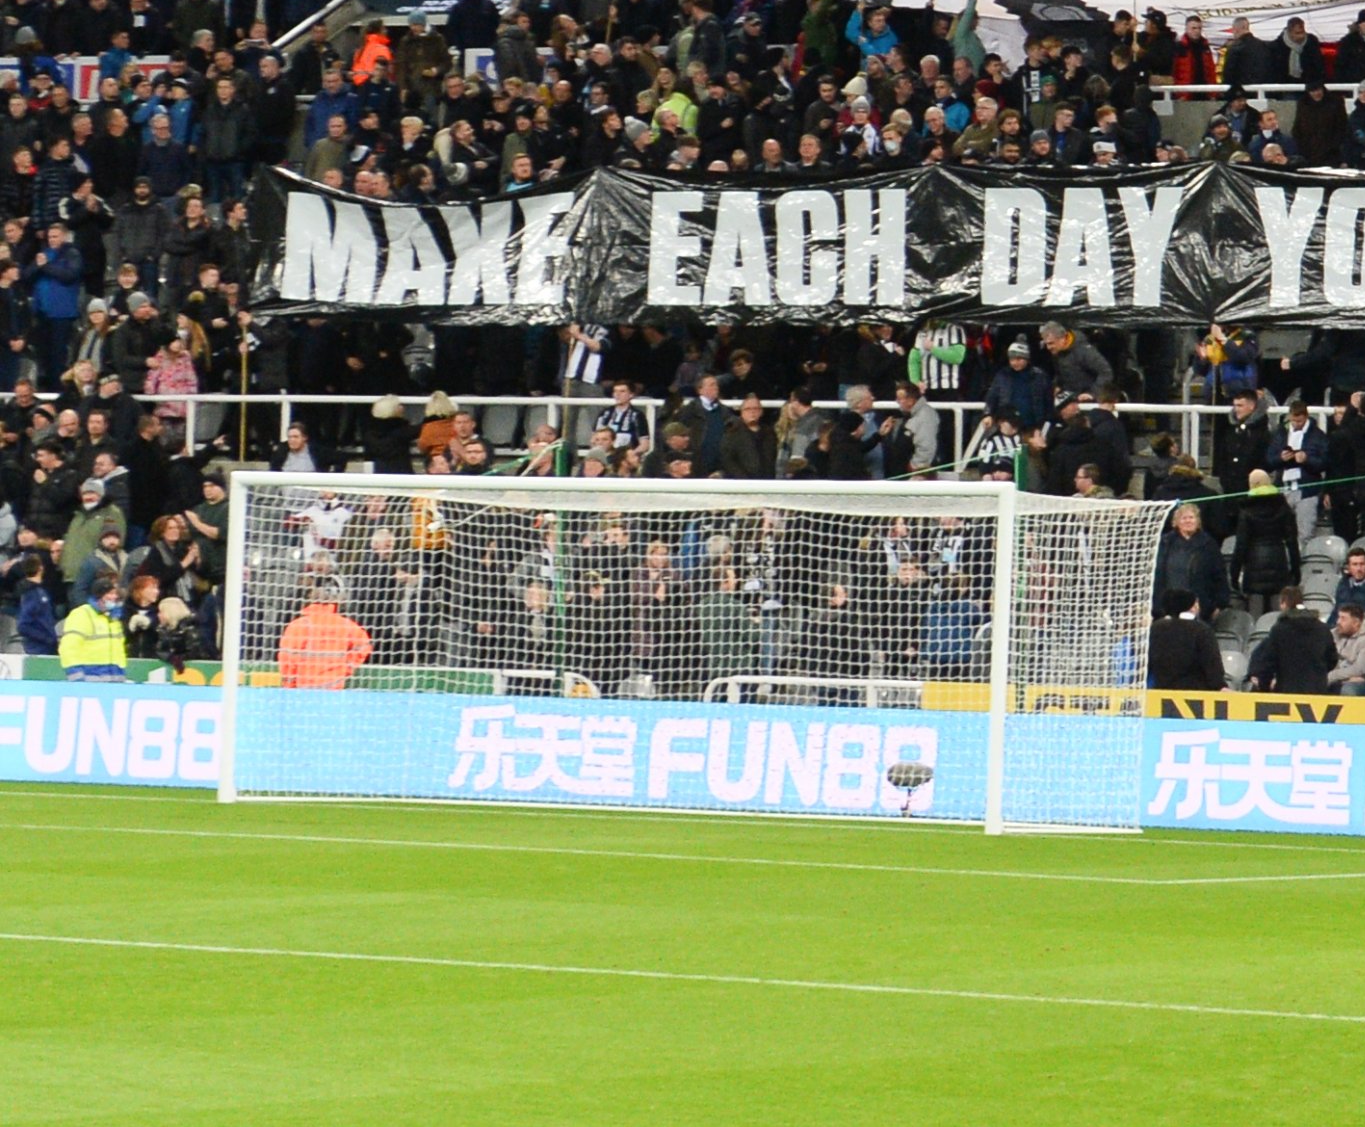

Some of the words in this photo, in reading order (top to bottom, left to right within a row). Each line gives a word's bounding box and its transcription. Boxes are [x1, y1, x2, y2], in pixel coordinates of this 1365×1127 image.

[281, 189, 576, 308] MAKE
[649, 188, 907, 307] EACH
[980, 186, 1184, 308] DAY
[448, 703, 637, 797] 乐天堂
[647, 718, 938, 810] FUN88
[1148, 727, 1352, 826] 乐天堂
